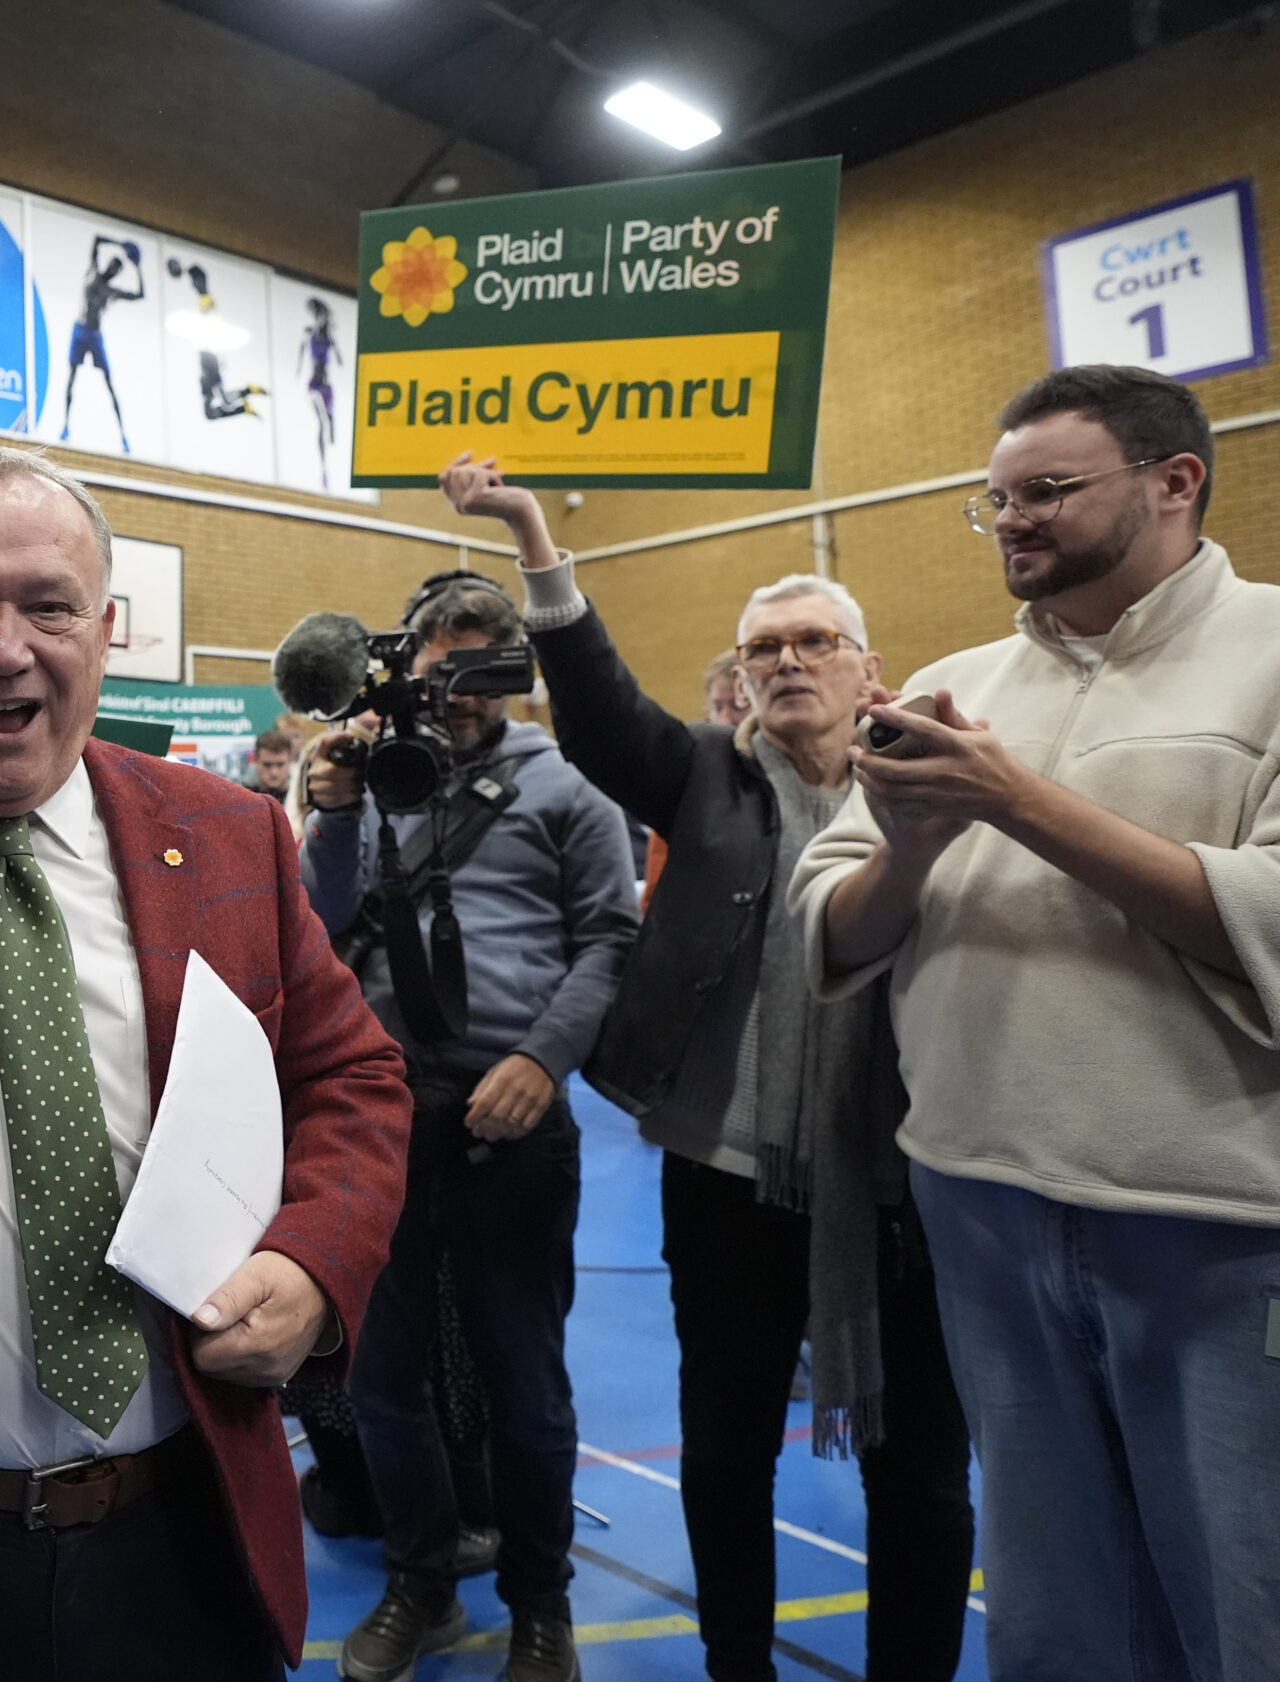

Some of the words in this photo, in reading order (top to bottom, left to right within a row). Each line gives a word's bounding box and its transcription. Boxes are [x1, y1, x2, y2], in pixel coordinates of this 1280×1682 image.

[476, 228, 564, 268] Plaid
[623, 215, 729, 256] Party
[735, 206, 780, 244] of
[1099, 227, 1190, 272] Cwrt
[474, 270, 594, 311] Cymru
[619, 256, 740, 294] Wales
[1094, 255, 1203, 302] Court
[1128, 303, 1167, 360] 1
[367, 375, 511, 427] Plaid
[527, 371, 752, 435] Cymru
